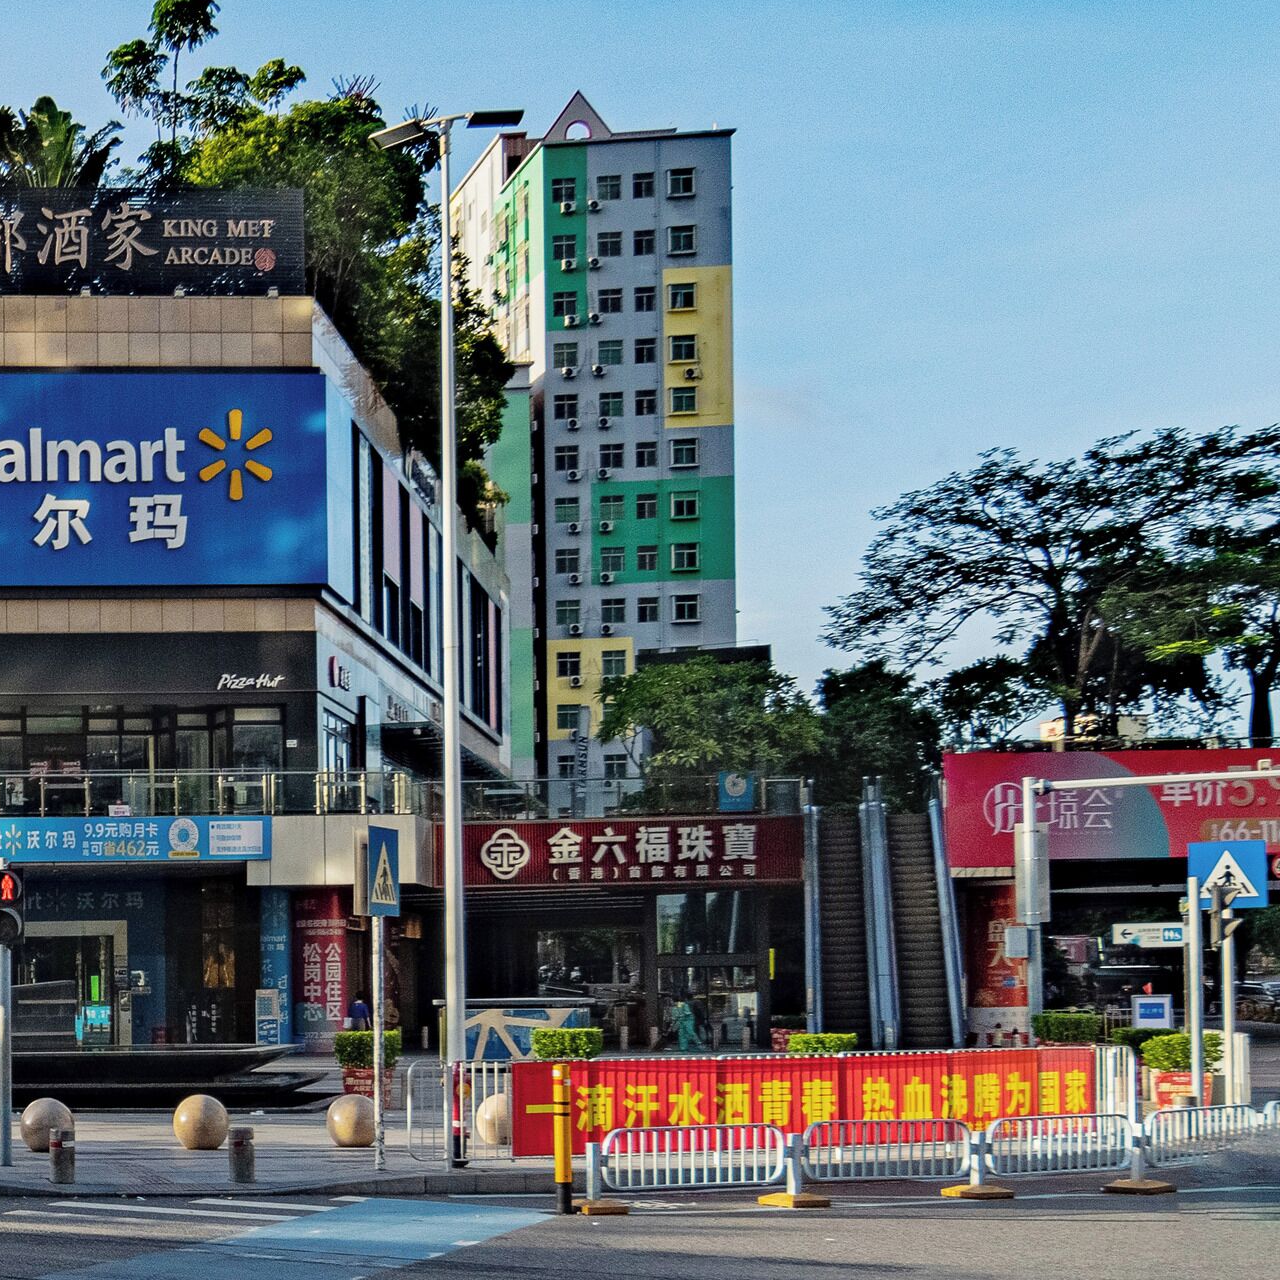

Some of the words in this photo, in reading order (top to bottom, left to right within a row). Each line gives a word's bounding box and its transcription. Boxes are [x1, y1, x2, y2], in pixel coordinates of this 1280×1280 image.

[162, 219, 218, 239] KING
[226, 219, 275, 239] MET
[163, 247, 254, 265] ARCADE
[216, 674, 255, 691] Pizza
[255, 673, 287, 689] Hut
[26, 829, 77, 850] 沃尔玛
[83, 822, 159, 838] 9.9元购月卡
[90, 840, 159, 857] 可省462元
[547, 822, 758, 864] 金六福珠寶
[77, 890, 145, 910] 沃尔玛
[303, 942, 322, 1022] 松岗中芯
[325, 942, 342, 1021] 公园住区
[525, 1078, 837, 1132] 一滴汗水洒青春
[863, 1070, 1089, 1122] 热血沸腾为国家
